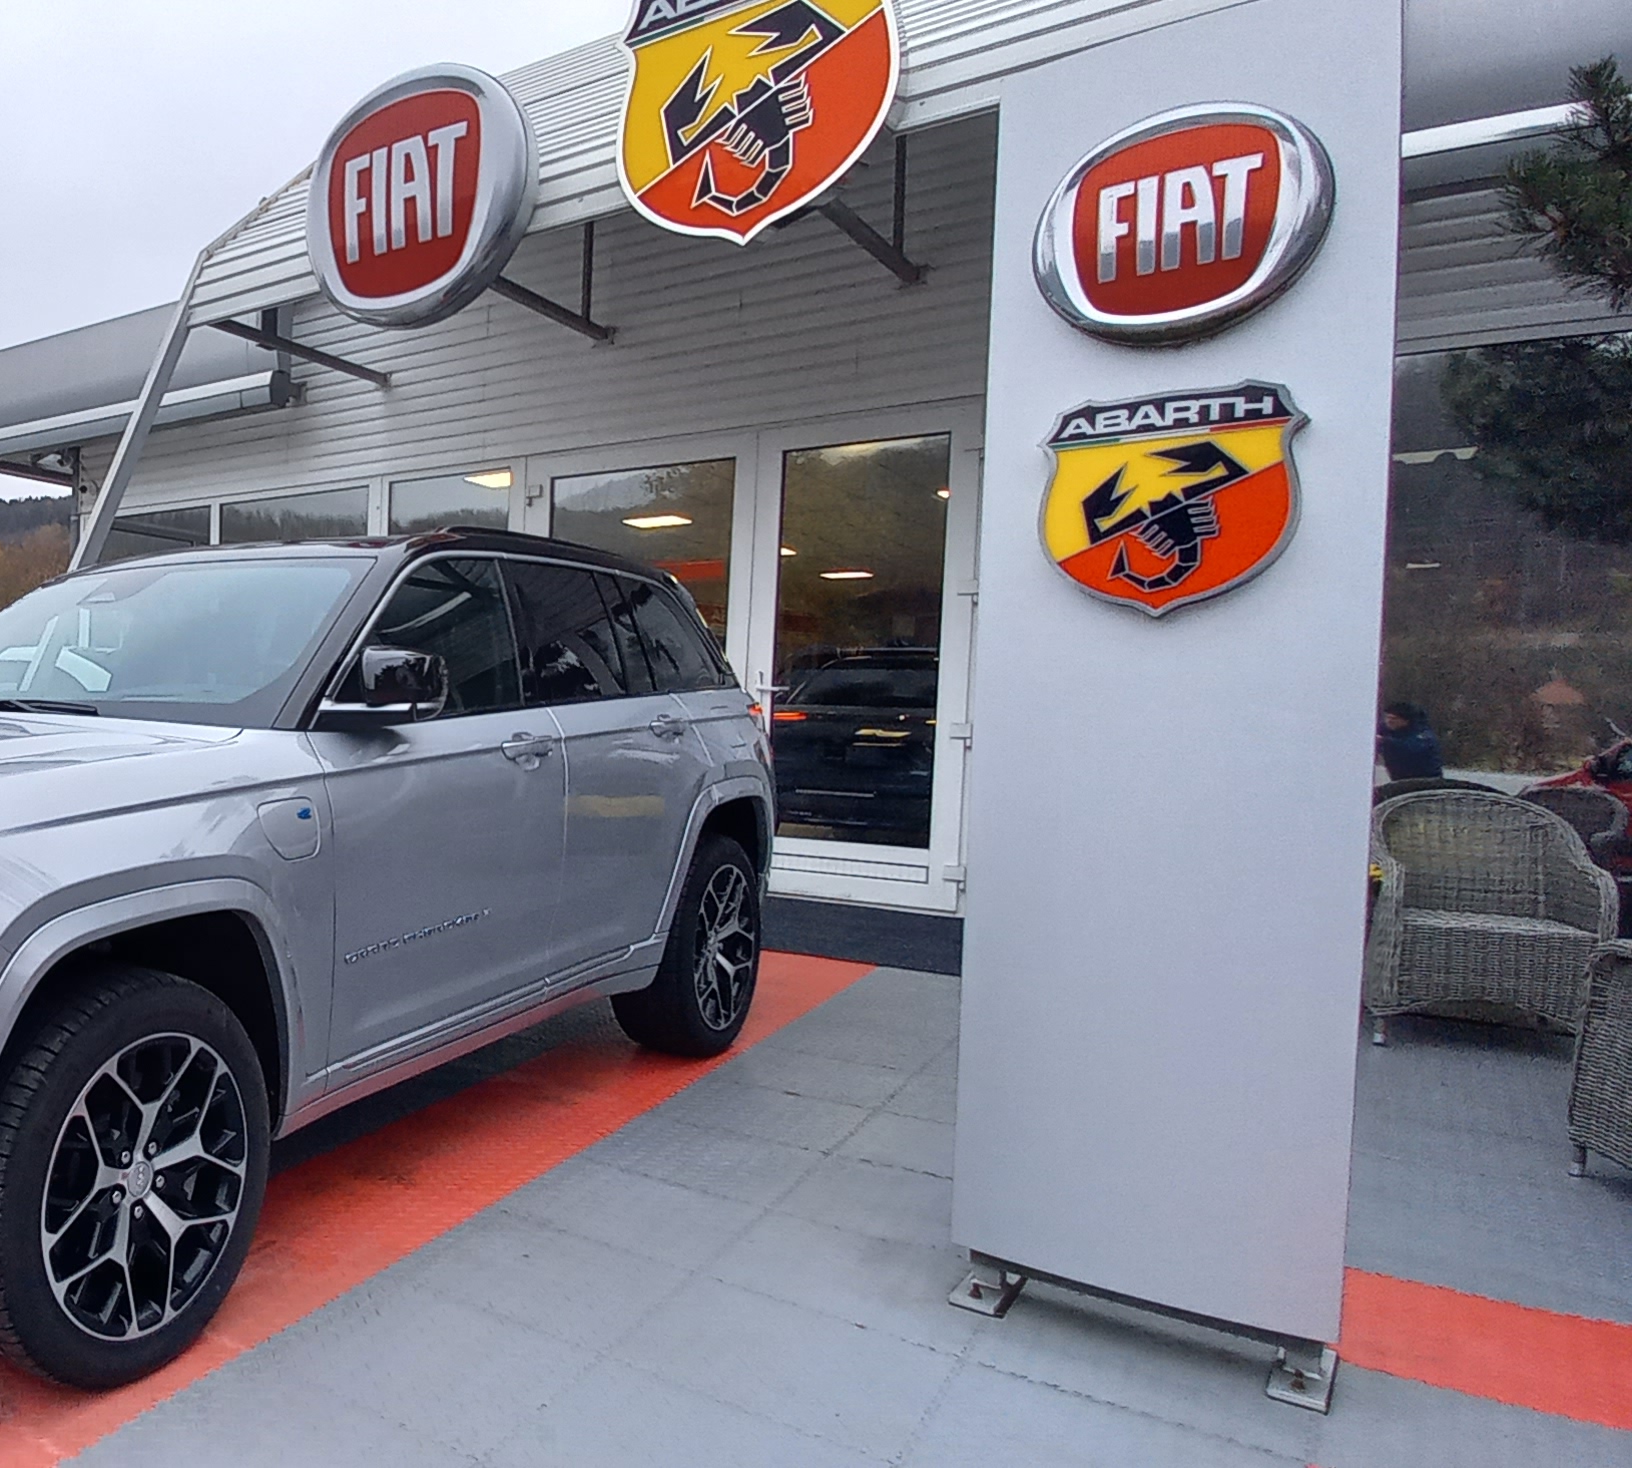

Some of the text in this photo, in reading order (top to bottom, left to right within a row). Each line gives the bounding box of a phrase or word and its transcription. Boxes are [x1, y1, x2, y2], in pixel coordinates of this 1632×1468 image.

[343, 120, 469, 265] FIAT
[1096, 152, 1265, 285] FIAT
[1058, 395, 1274, 439] ABARTH
